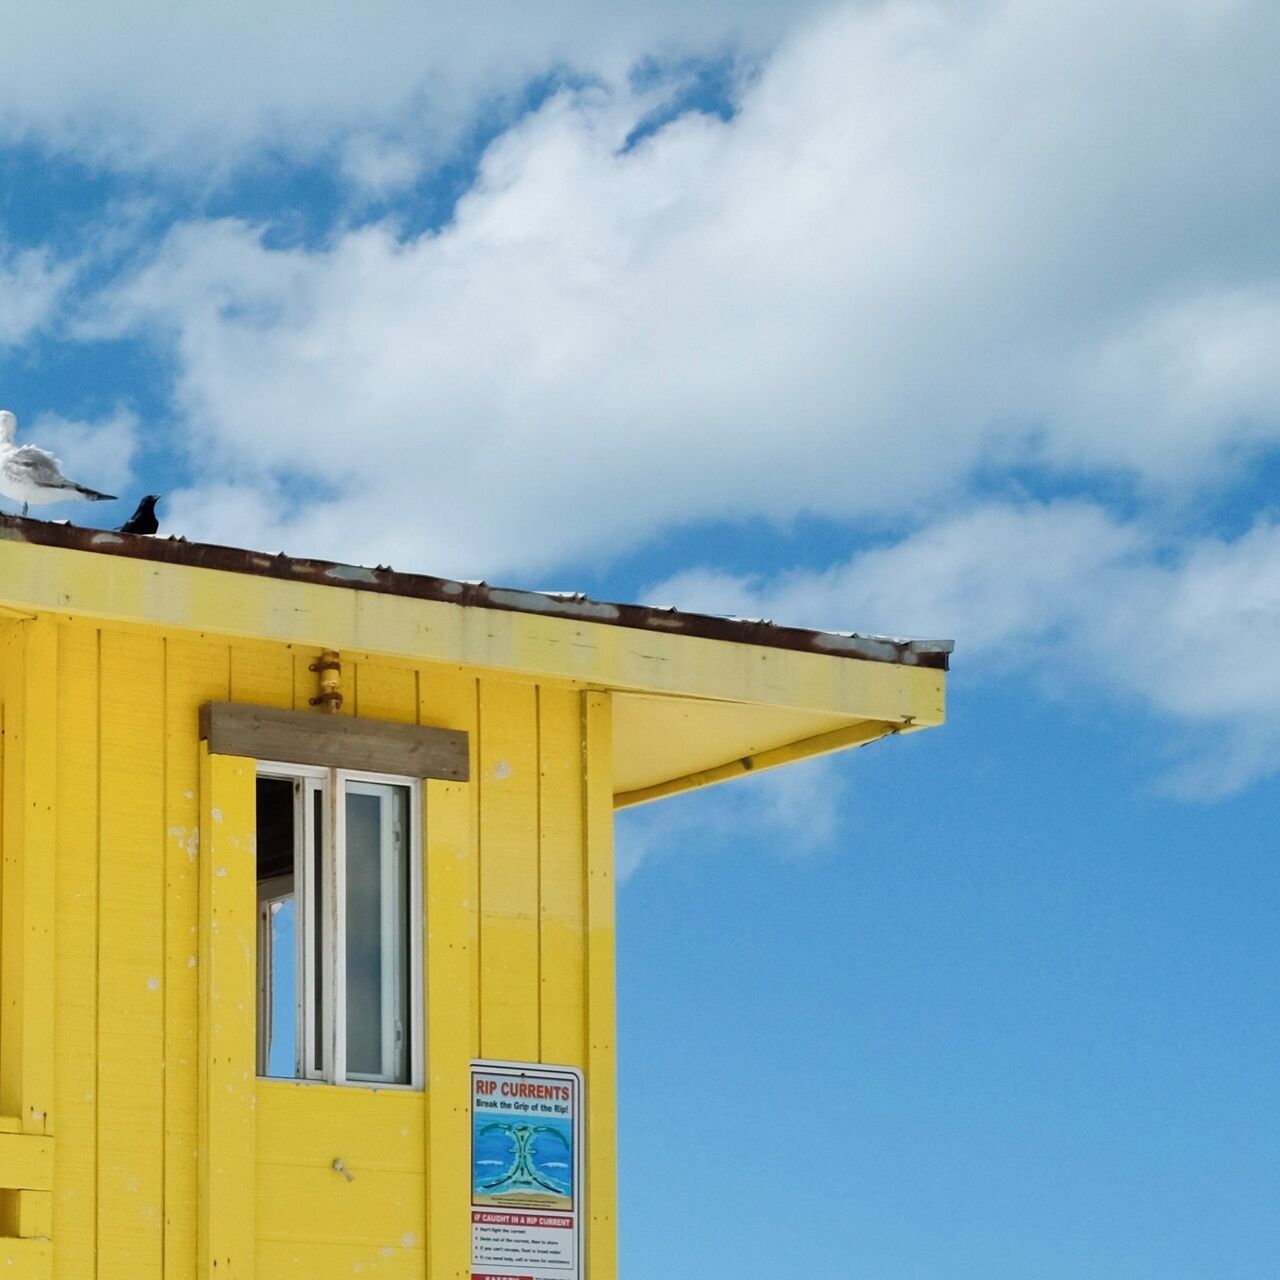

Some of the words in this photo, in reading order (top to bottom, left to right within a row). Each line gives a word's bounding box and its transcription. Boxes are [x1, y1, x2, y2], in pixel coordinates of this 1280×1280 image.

[476, 1080, 497, 1095] RIP
[501, 1082, 569, 1100] CURRENTS
[476, 1099, 498, 1108] Break
[500, 1101, 511, 1109] the
[514, 1102, 529, 1111] Grip
[531, 1103, 539, 1111] of
[541, 1104, 552, 1112] the
[554, 1105, 568, 1114] Rip!
[482, 1215, 510, 1223] CAUGHT
[539, 1218, 570, 1226] CURRENT
